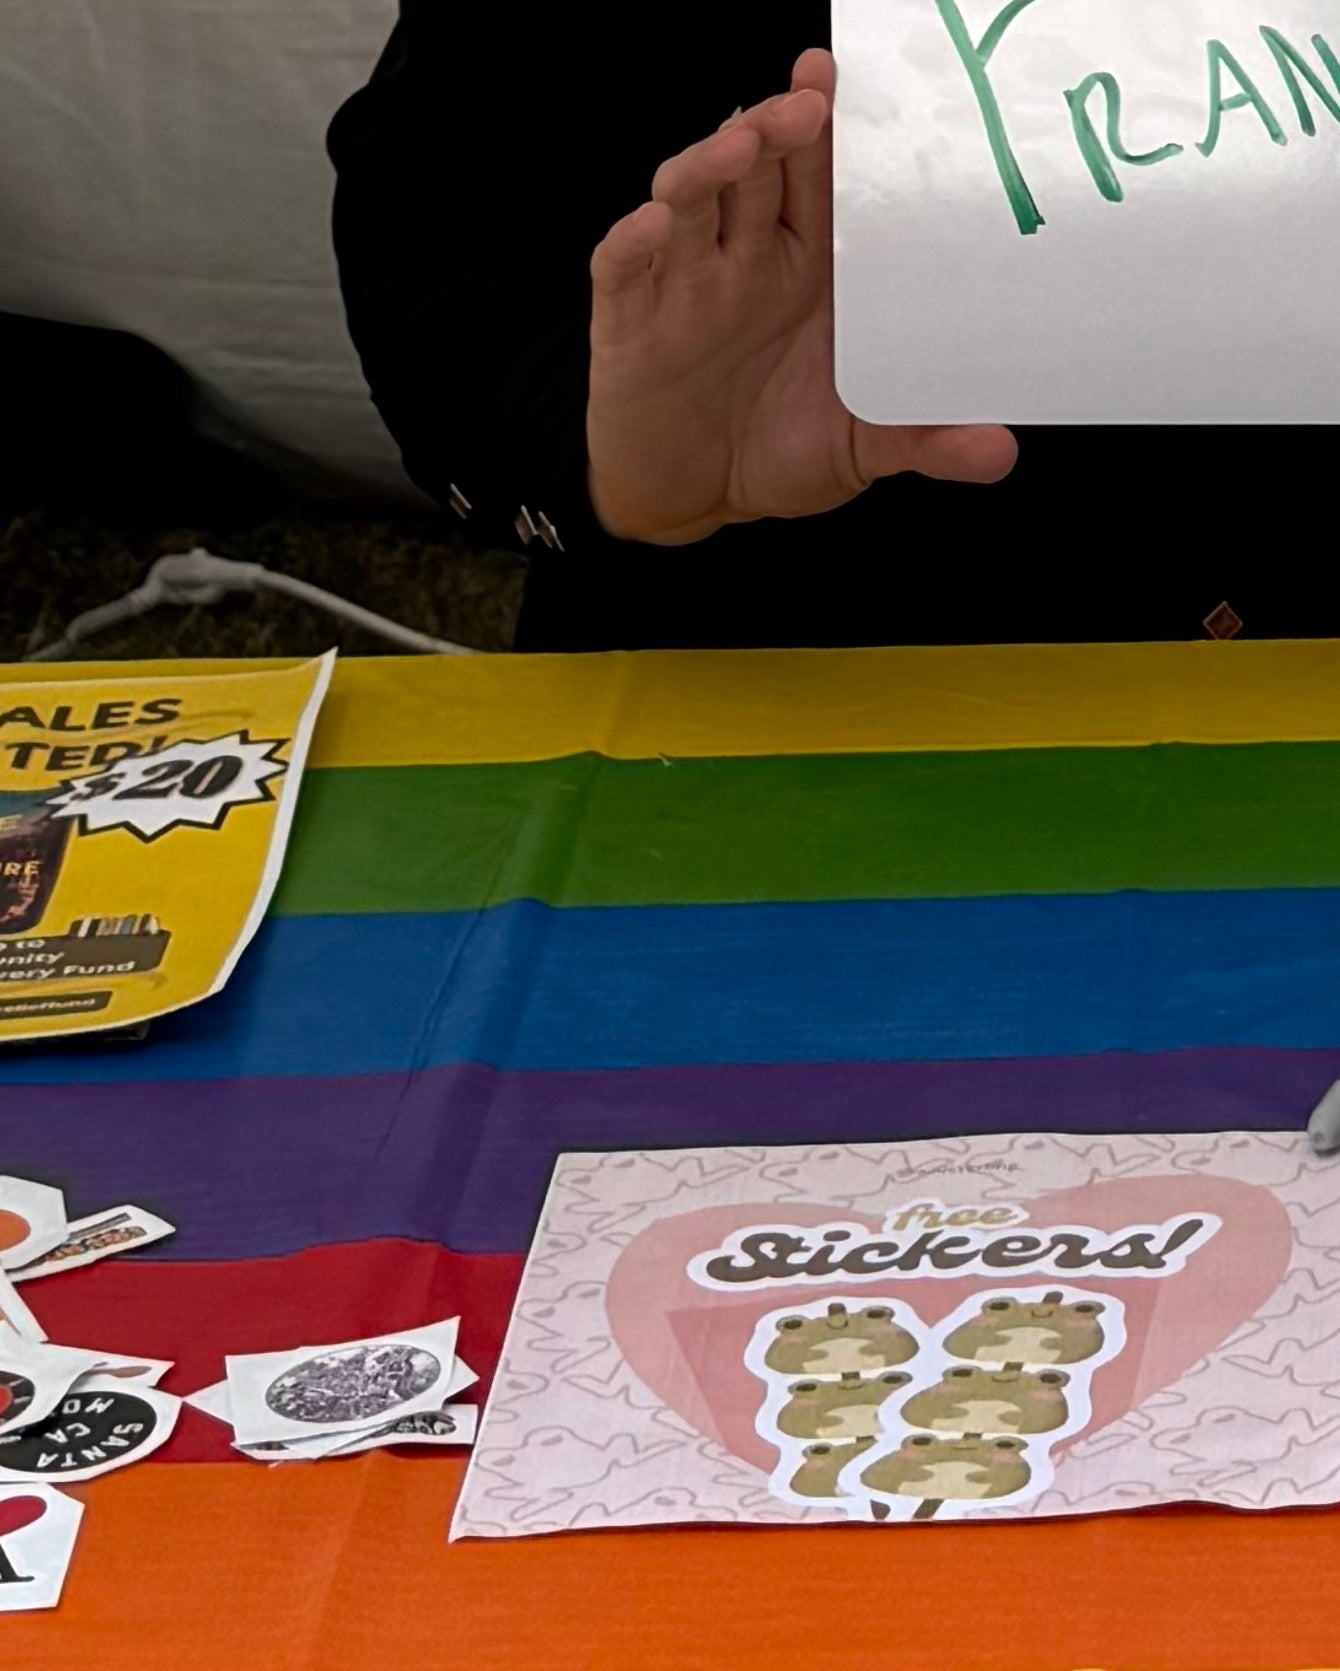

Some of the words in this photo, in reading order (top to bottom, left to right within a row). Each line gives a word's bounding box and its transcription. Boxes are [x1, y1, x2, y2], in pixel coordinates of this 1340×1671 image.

[70, 755, 243, 802] $20
[63, 960, 136, 976] Fund
[892, 1203, 1019, 1231] free
[706, 1218, 1205, 1283] Stickers!
[37, 1422, 144, 1468] SANTA
